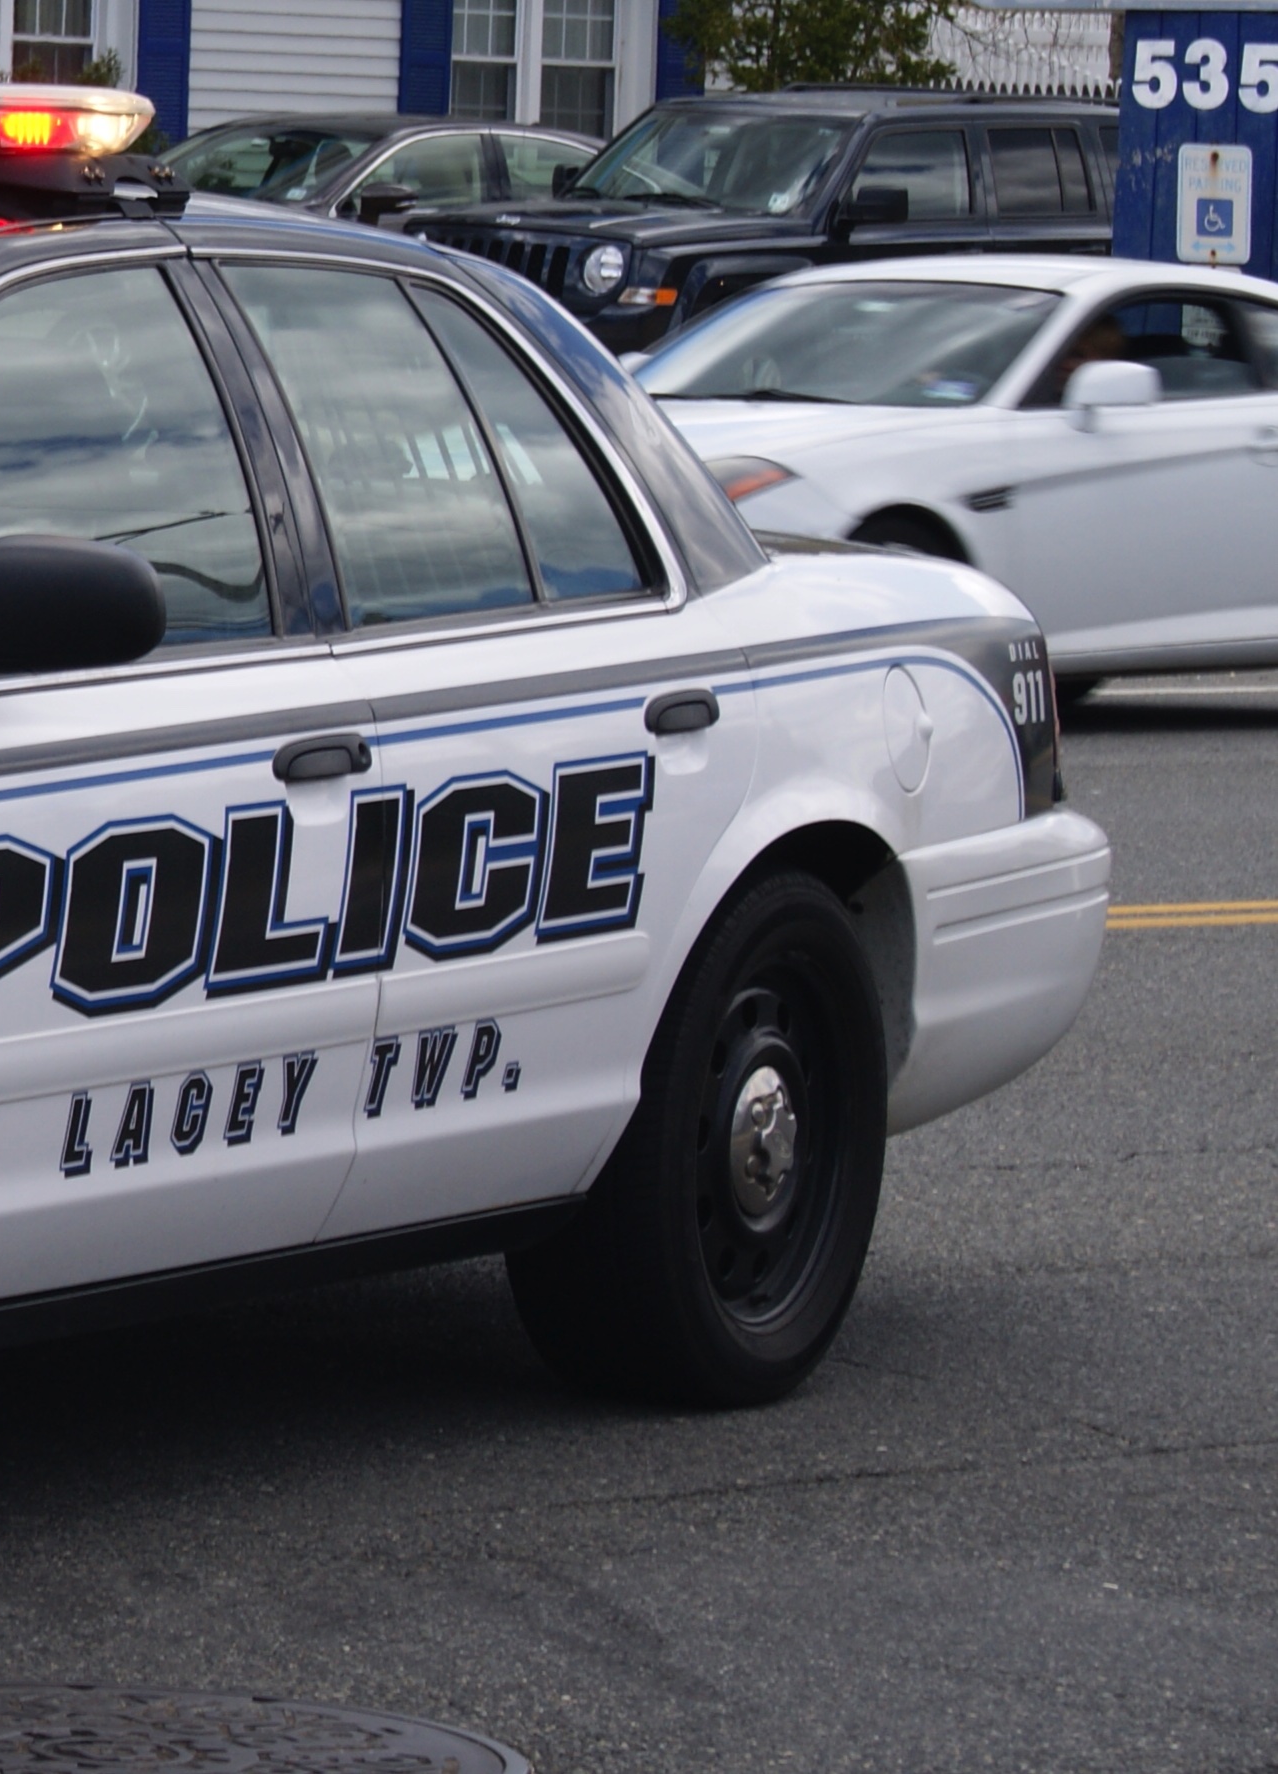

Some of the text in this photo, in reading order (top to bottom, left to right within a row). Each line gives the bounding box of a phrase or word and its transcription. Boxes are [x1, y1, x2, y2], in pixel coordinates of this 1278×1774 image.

[1131, 37, 1278, 114] 535
[1185, 156, 1248, 174] RESVED
[1188, 177, 1242, 193] PAING
[1008, 641, 1039, 662] DIAL
[1012, 669, 1045, 726] 911
[59, 1018, 521, 1178] LACEY TWP.
